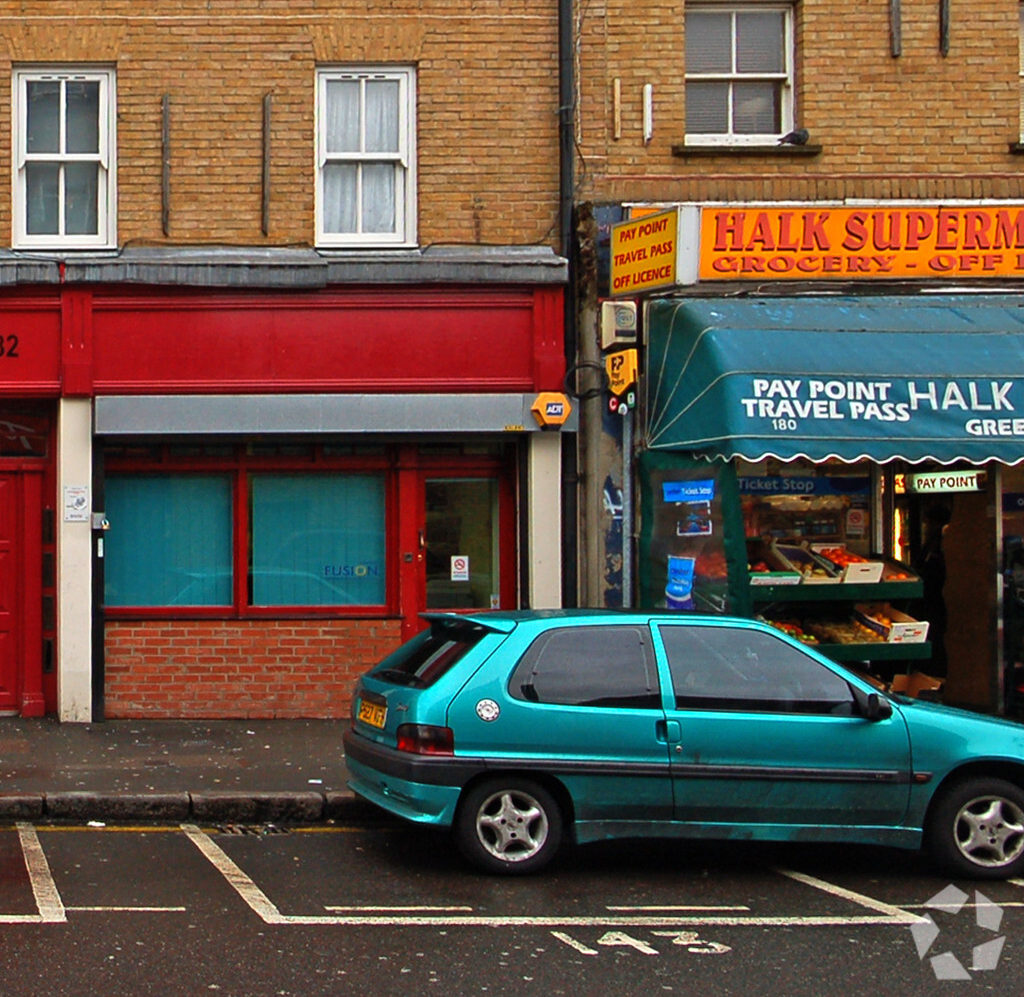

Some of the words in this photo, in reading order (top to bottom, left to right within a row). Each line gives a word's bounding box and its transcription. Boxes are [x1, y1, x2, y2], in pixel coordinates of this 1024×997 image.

[619, 228, 636, 242] PAY
[638, 218, 669, 237] POINT
[713, 211, 831, 252] HALK
[614, 247, 648, 266] TRAVEL
[650, 240, 673, 257] PASS
[712, 256, 897, 272] GROCERY
[928, 254, 1004, 271] OFF
[613, 274, 631, 289] OFF
[632, 264, 672, 285] LICENCE
[753, 379, 801, 398] PAY
[809, 380, 891, 401] POINT
[907, 381, 1015, 411] HALK
[546, 404, 564, 414] ADT
[741, 399, 844, 419] TRAVEL
[850, 401, 911, 422] PASS
[771, 419, 797, 431] 180
[738, 478, 778, 491] Ticket
[782, 478, 815, 492] Stop
[917, 478, 936, 489] PAY
[939, 476, 976, 488] POINT
[325, 565, 378, 577] FUSION
[550, 931, 732, 954] 143
